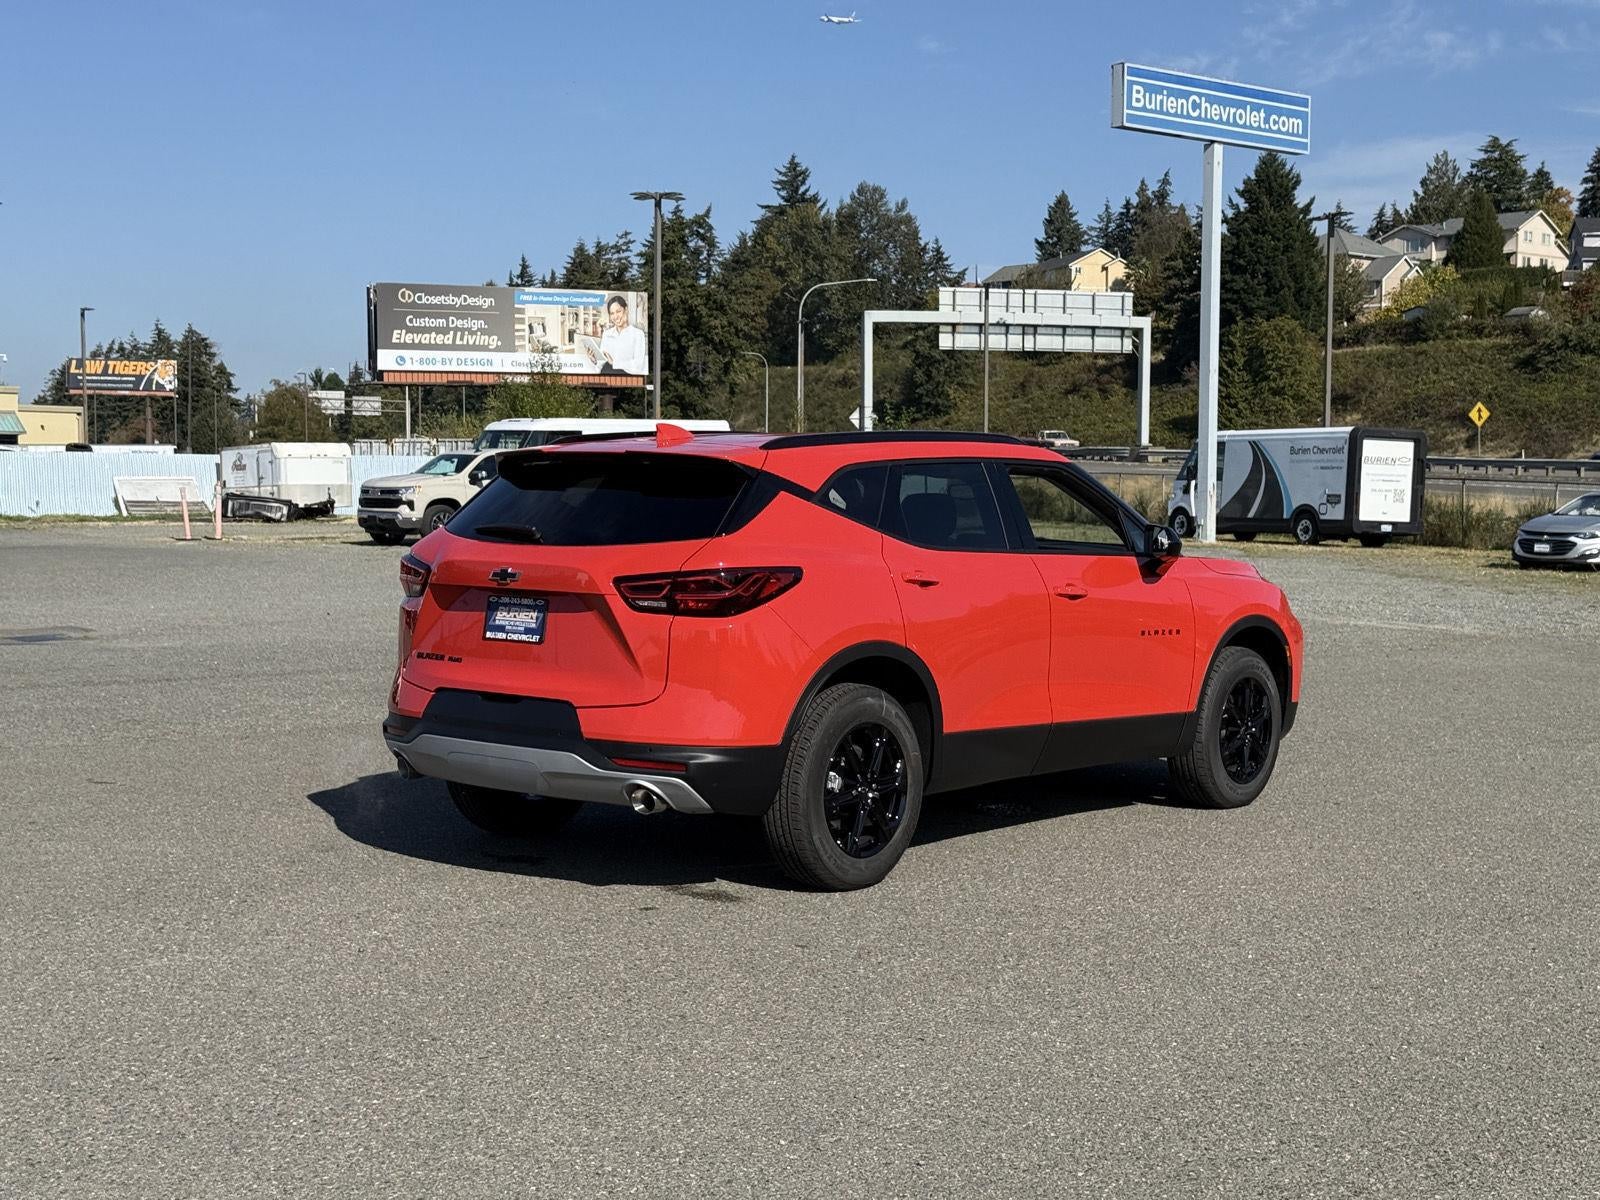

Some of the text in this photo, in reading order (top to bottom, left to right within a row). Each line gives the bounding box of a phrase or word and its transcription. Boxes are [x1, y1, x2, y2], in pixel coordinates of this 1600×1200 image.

[1131, 84, 1303, 135] BurienChevrolet.com
[414, 292, 495, 308] ClosetsbyDesign
[405, 315, 488, 330] Custom Design.
[391, 329, 502, 348] Elevated Living.
[69, 359, 156, 375] LAW TIGERS
[409, 357, 493, 367] 1-800-BY DESIGN
[510, 360, 584, 369] Closesign.com
[1290, 444, 1345, 455] Burien Chevrolet
[1363, 455, 1397, 466] BURIEN
[496, 606, 538, 620] BURIEN
[507, 633, 540, 642] CHEVROLET
[416, 651, 445, 661] BLAZER
